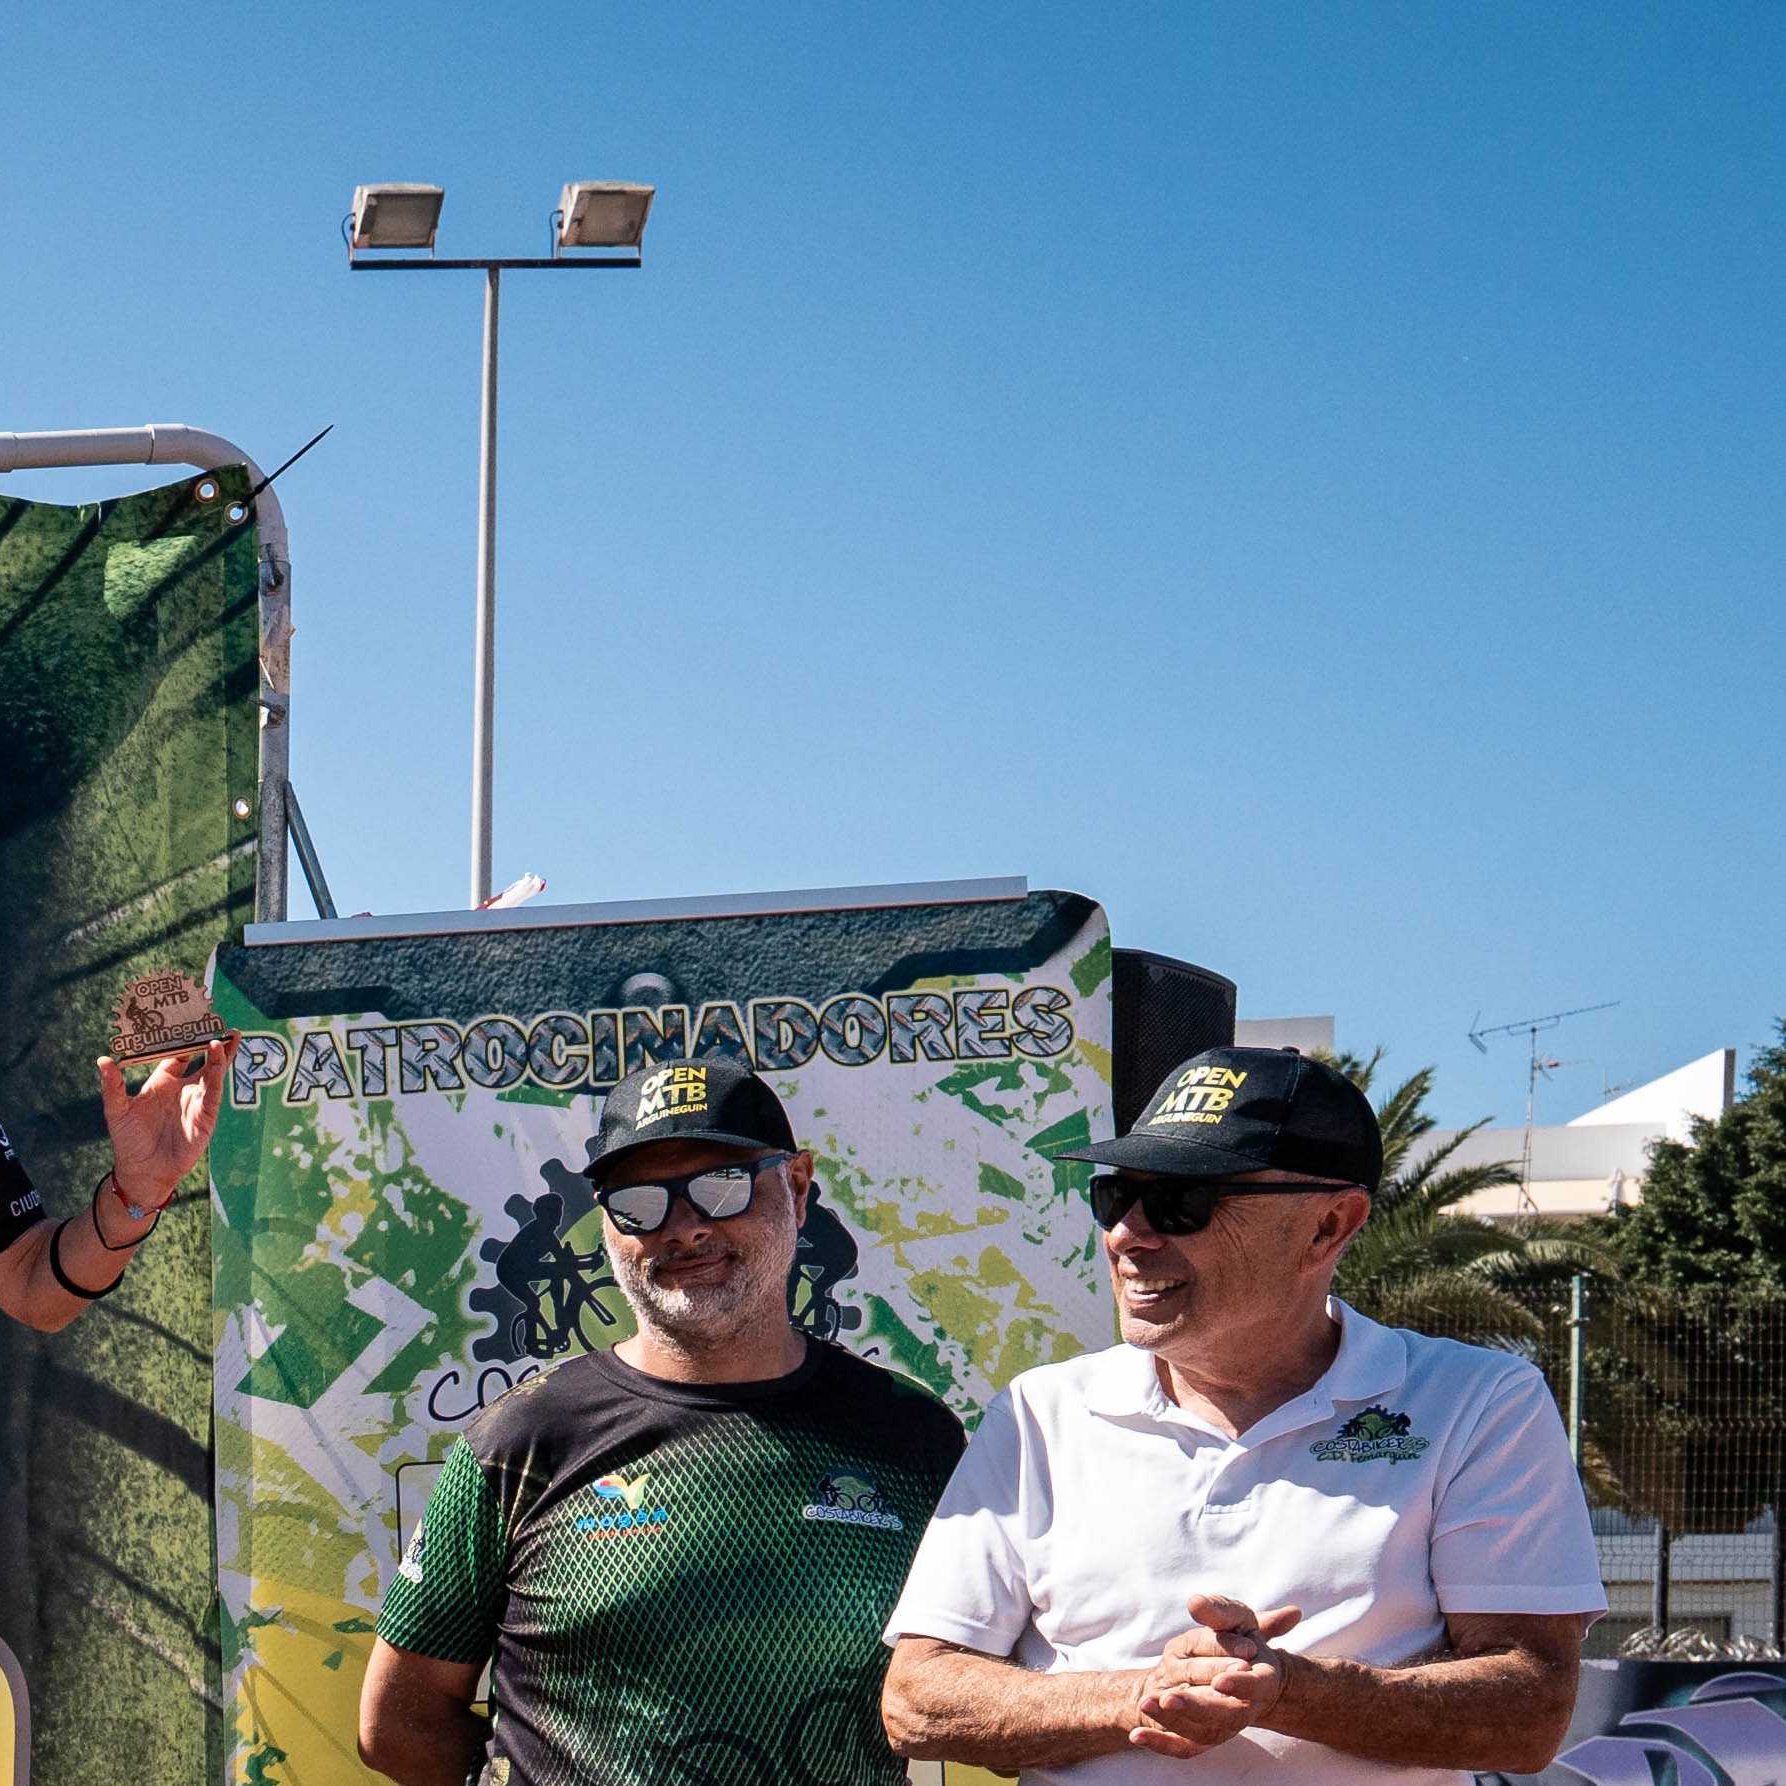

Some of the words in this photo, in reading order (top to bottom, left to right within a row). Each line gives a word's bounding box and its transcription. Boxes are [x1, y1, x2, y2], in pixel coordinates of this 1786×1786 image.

[136, 976, 182, 997] OPEN
[154, 991, 189, 1009] MTB
[229, 986, 1077, 1106] PATROCINADORES
[641, 1067, 706, 1096] OPEN
[1177, 1066, 1247, 1088] OPEN
[635, 1083, 706, 1120] MTB
[1155, 1085, 1234, 1116] MTB
